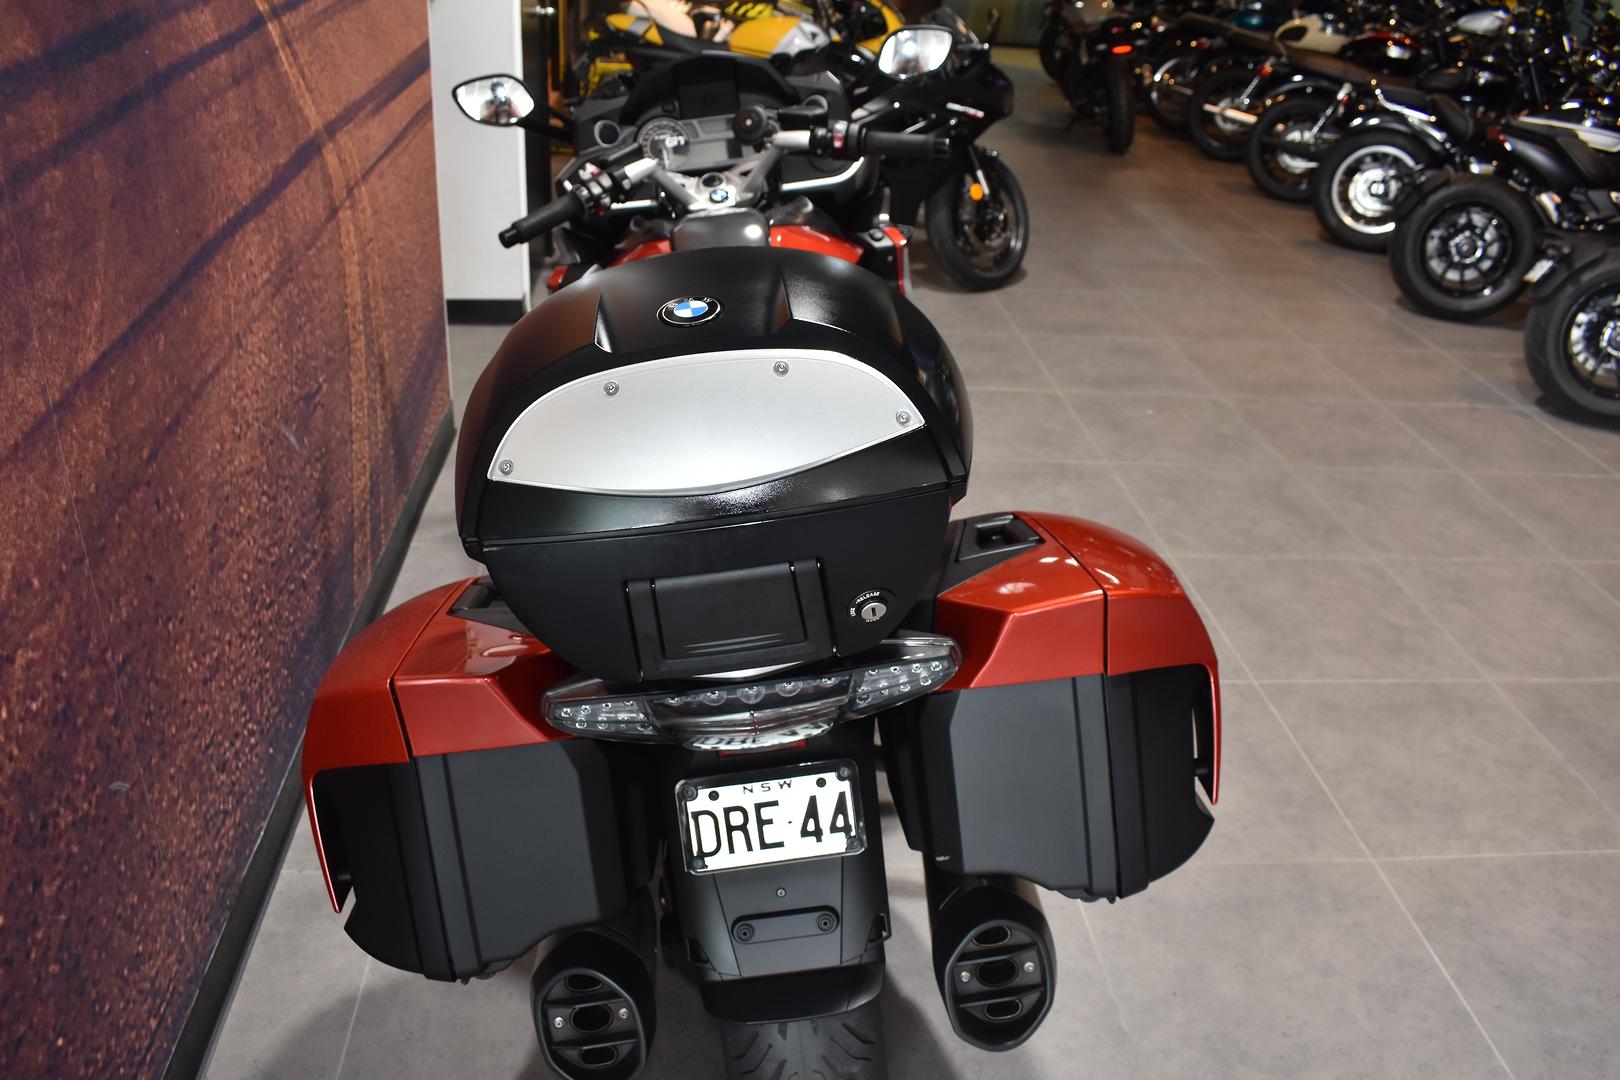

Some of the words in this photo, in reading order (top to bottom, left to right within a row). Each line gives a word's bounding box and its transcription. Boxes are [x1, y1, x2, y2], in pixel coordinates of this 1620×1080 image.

[857, 591, 880, 603] RELEASE
[743, 780, 792, 795] NSW
[691, 800, 784, 858] DRE
[800, 791, 852, 843] 44
